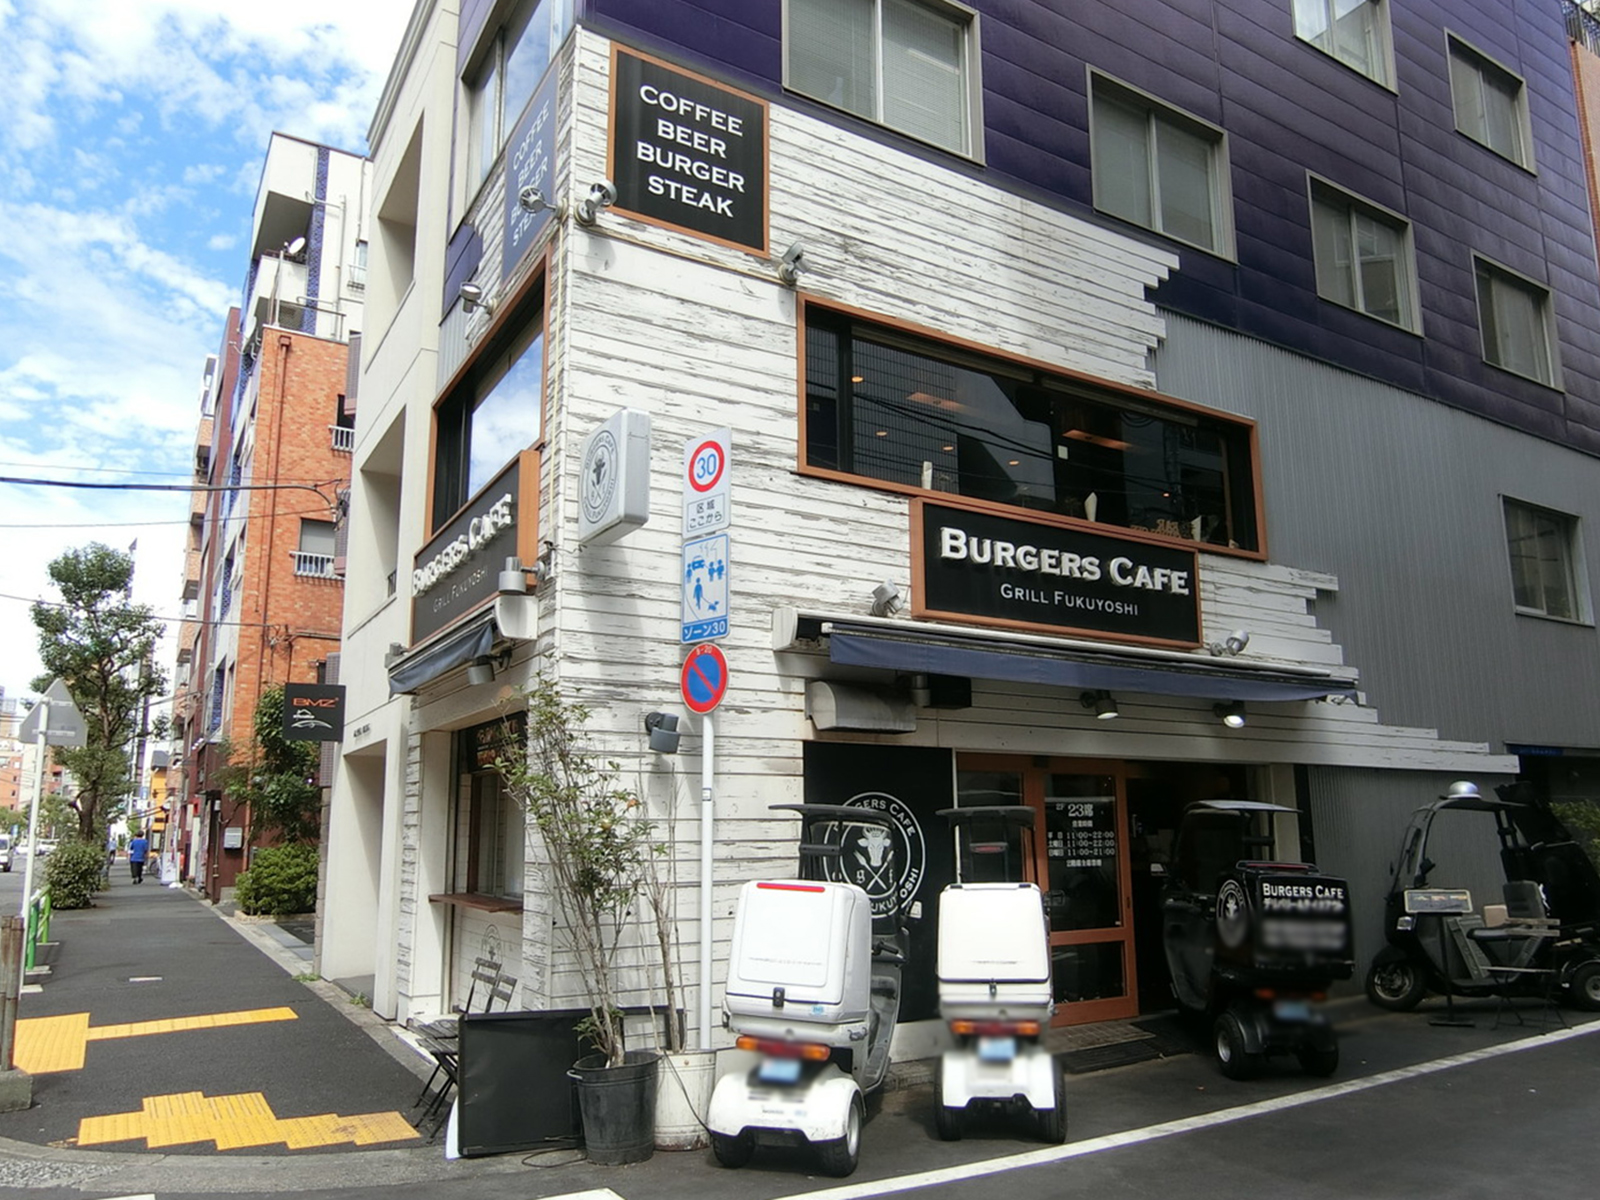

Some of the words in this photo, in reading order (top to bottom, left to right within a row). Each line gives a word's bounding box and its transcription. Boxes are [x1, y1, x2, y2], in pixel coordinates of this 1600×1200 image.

[639, 84, 743, 137] COFFEE
[513, 99, 550, 170] COFFEE
[657, 119, 727, 158] BEER
[518, 140, 543, 188] BEER
[636, 141, 745, 193] BURGER
[511, 156, 548, 226] BUGER
[648, 175, 734, 218] STEAK
[696, 453, 717, 479] 30
[689, 511, 722, 529] ここから
[696, 499, 715, 514] 区域
[412, 534, 469, 597] BURGERS
[469, 493, 512, 550] CAFE
[940, 526, 1101, 581] BURGERS
[1109, 556, 1190, 596] CAFE
[433, 592, 451, 612] GRILL
[451, 565, 489, 601] FUKUYOSHI
[1000, 583, 1049, 604] GRILL
[1054, 590, 1138, 616] FUKUYOSHI
[889, 804, 916, 837] CAFE
[871, 868, 919, 912] UKUYOSHI
[1262, 883, 1313, 897] BURGERS
[1315, 885, 1344, 899] CAFE
